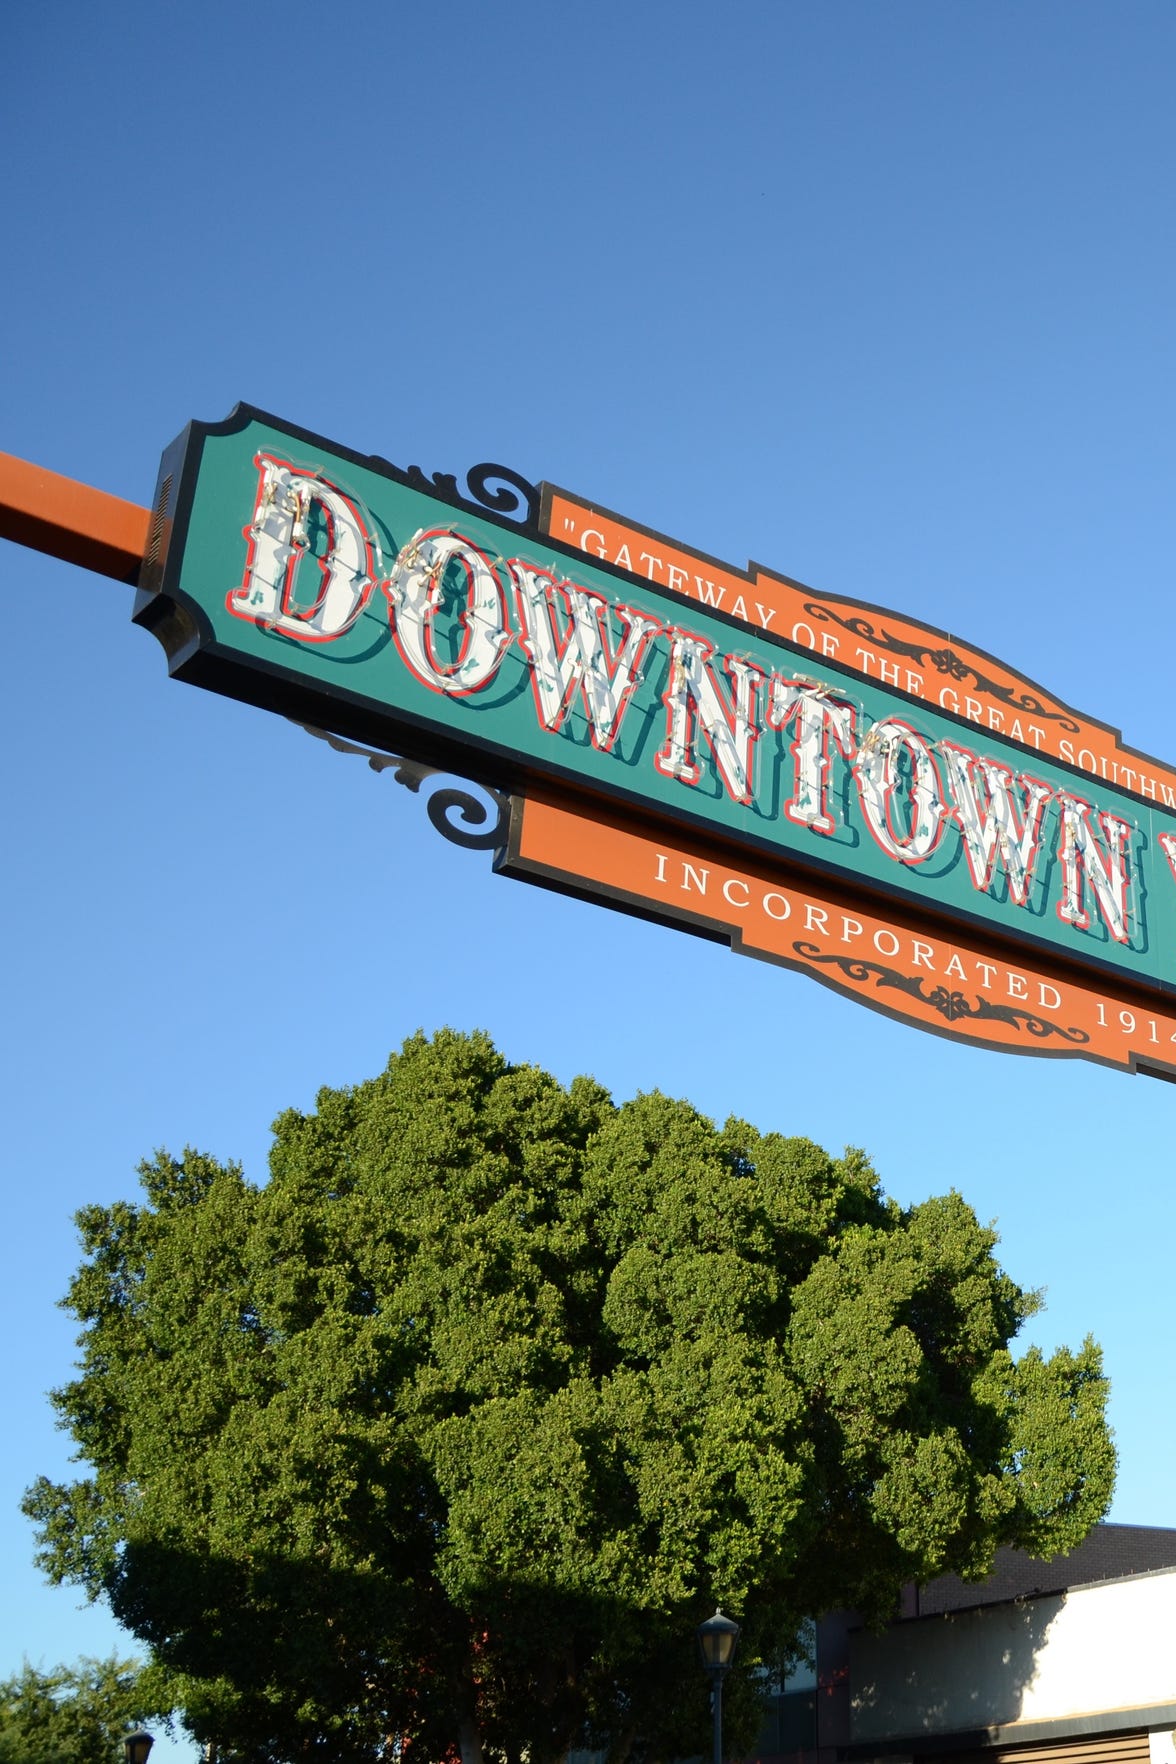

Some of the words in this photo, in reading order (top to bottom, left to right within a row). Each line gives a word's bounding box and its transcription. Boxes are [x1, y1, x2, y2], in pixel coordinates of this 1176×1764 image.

[226, 451, 1132, 945] DOWNTOWN
[563, 518, 776, 632] "GATEWAY
[791, 622, 840, 660] OF
[856, 647, 925, 699] THE
[938, 687, 1046, 750] GREAT
[653, 854, 1063, 1011] INCORPORATED
